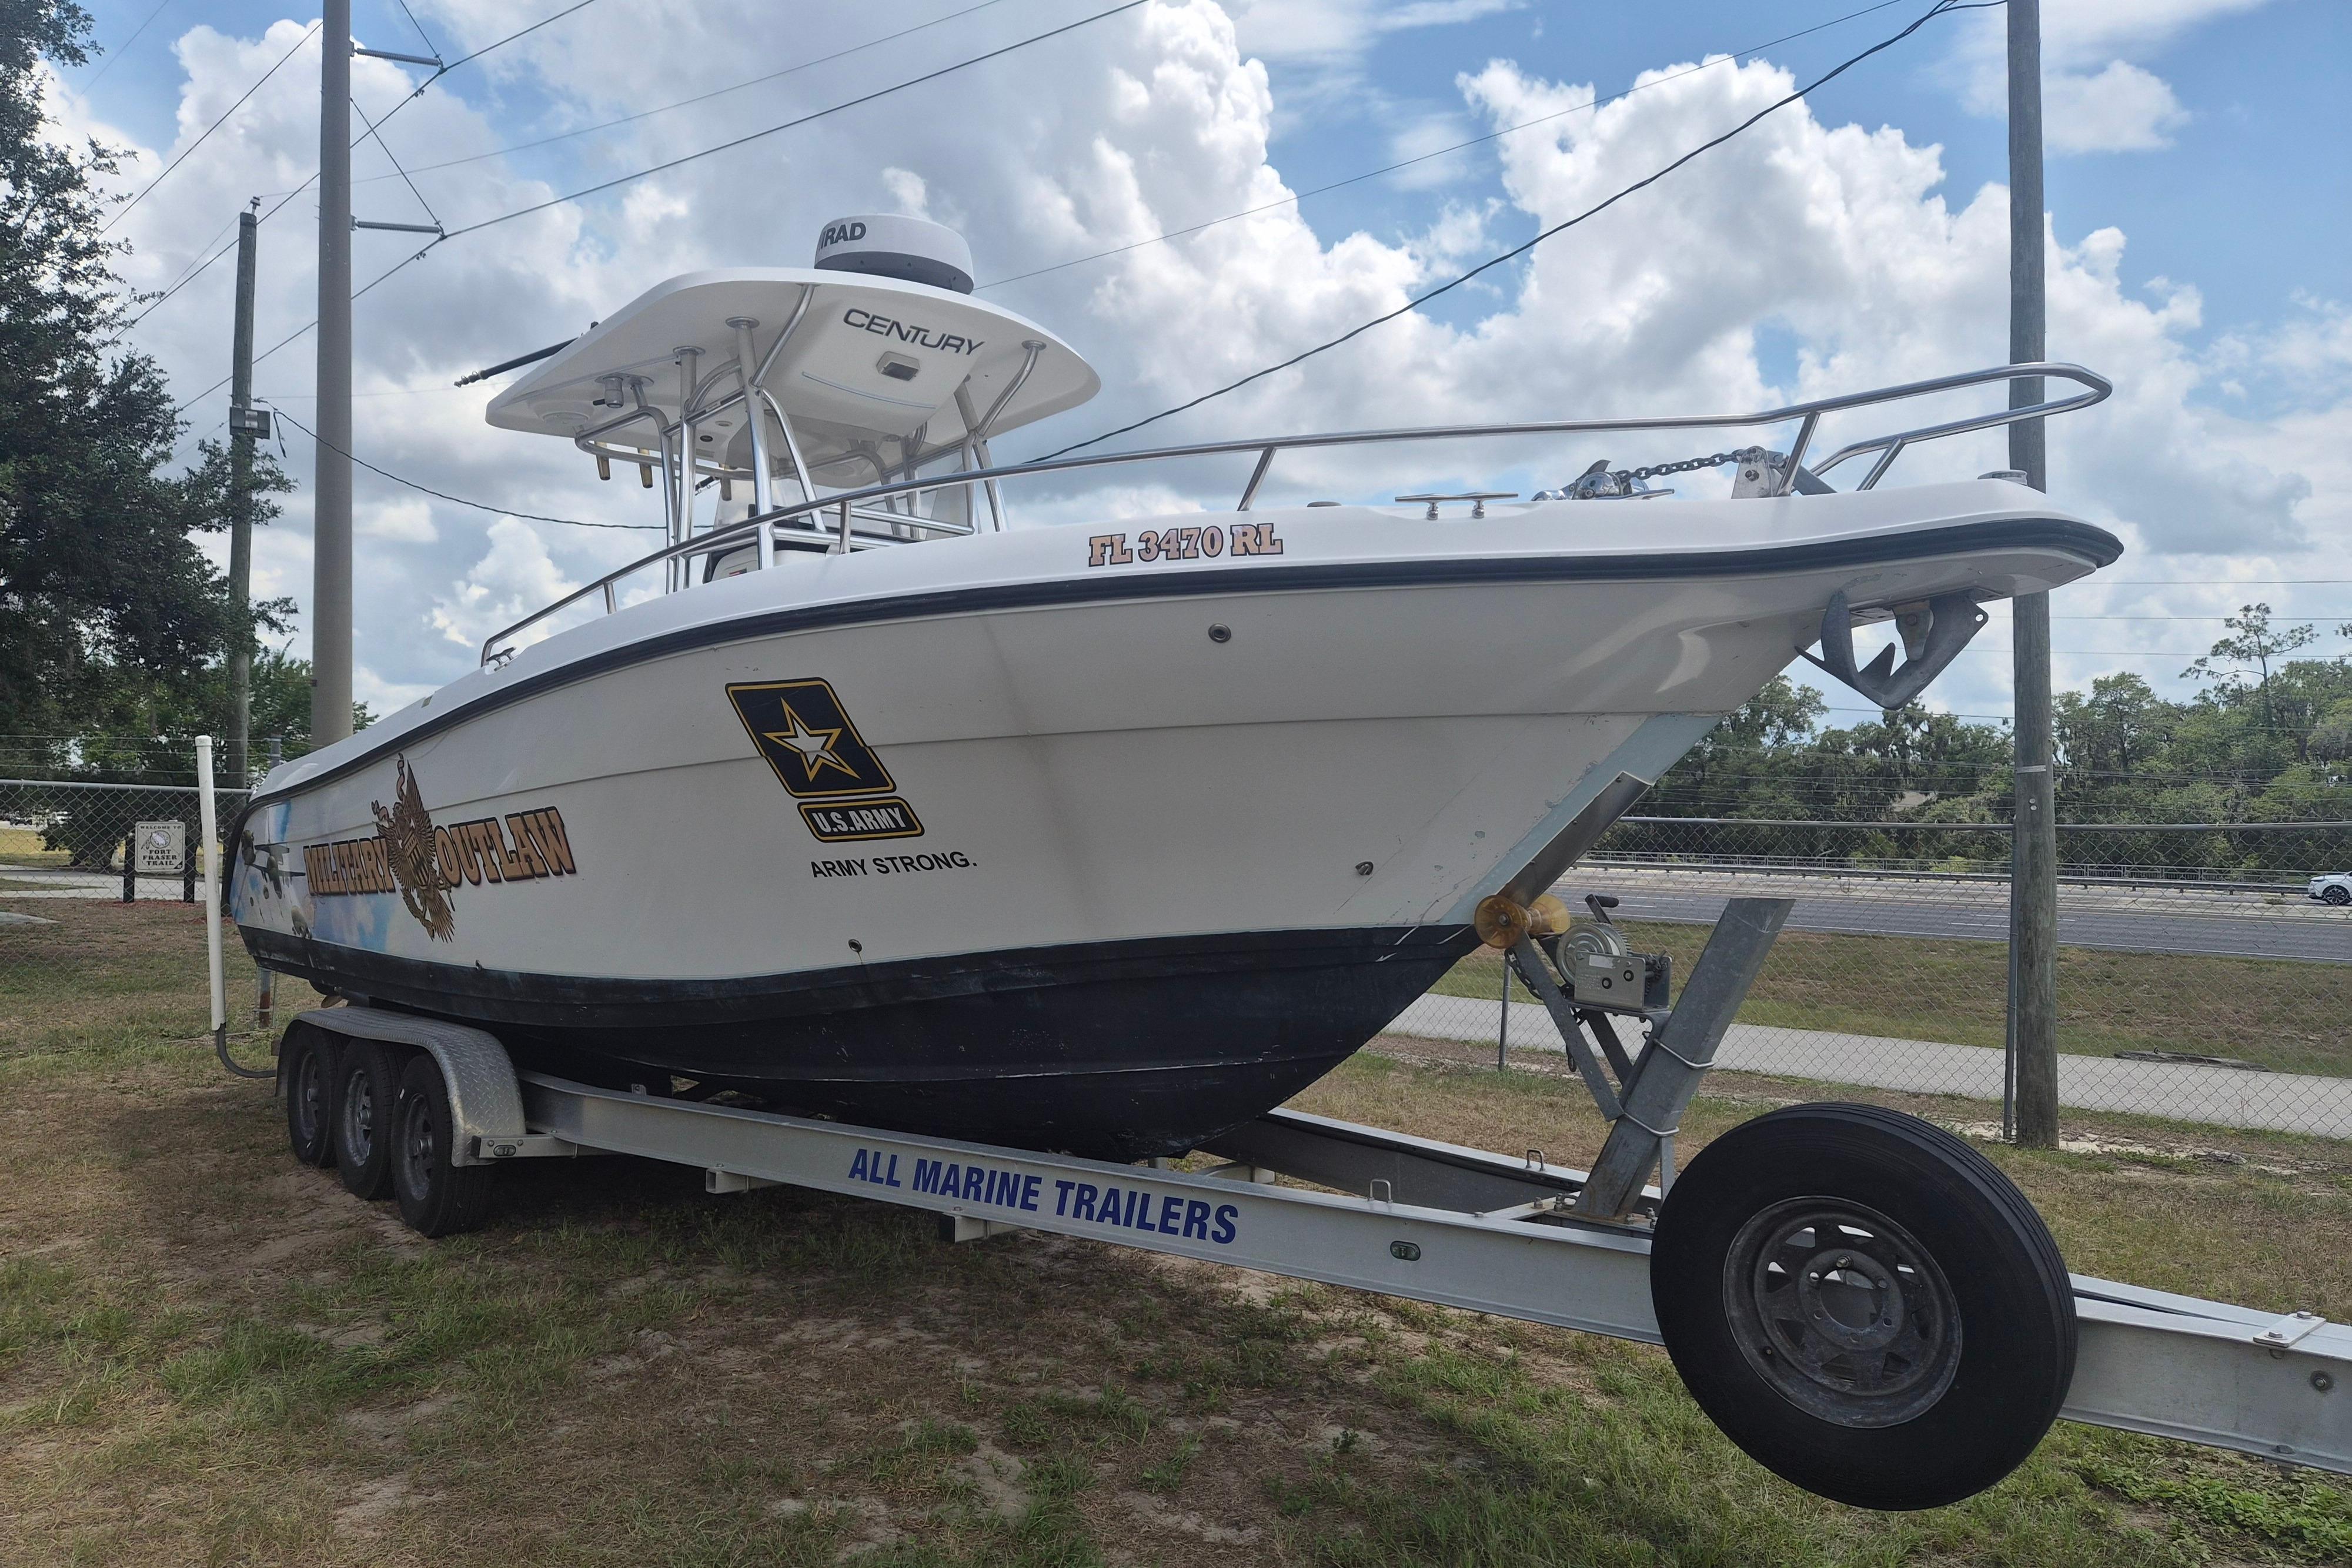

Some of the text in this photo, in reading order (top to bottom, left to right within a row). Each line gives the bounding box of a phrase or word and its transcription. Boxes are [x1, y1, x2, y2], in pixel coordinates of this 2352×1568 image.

[843, 307, 985, 356] CENTURY
[1088, 523, 1284, 567] FL 3470 RL
[303, 805, 577, 896] MILITARY OUTLAW
[811, 851, 978, 878] ARMY STRONG.
[848, 1148, 1239, 1245] ALL MARINE TRAILERS
